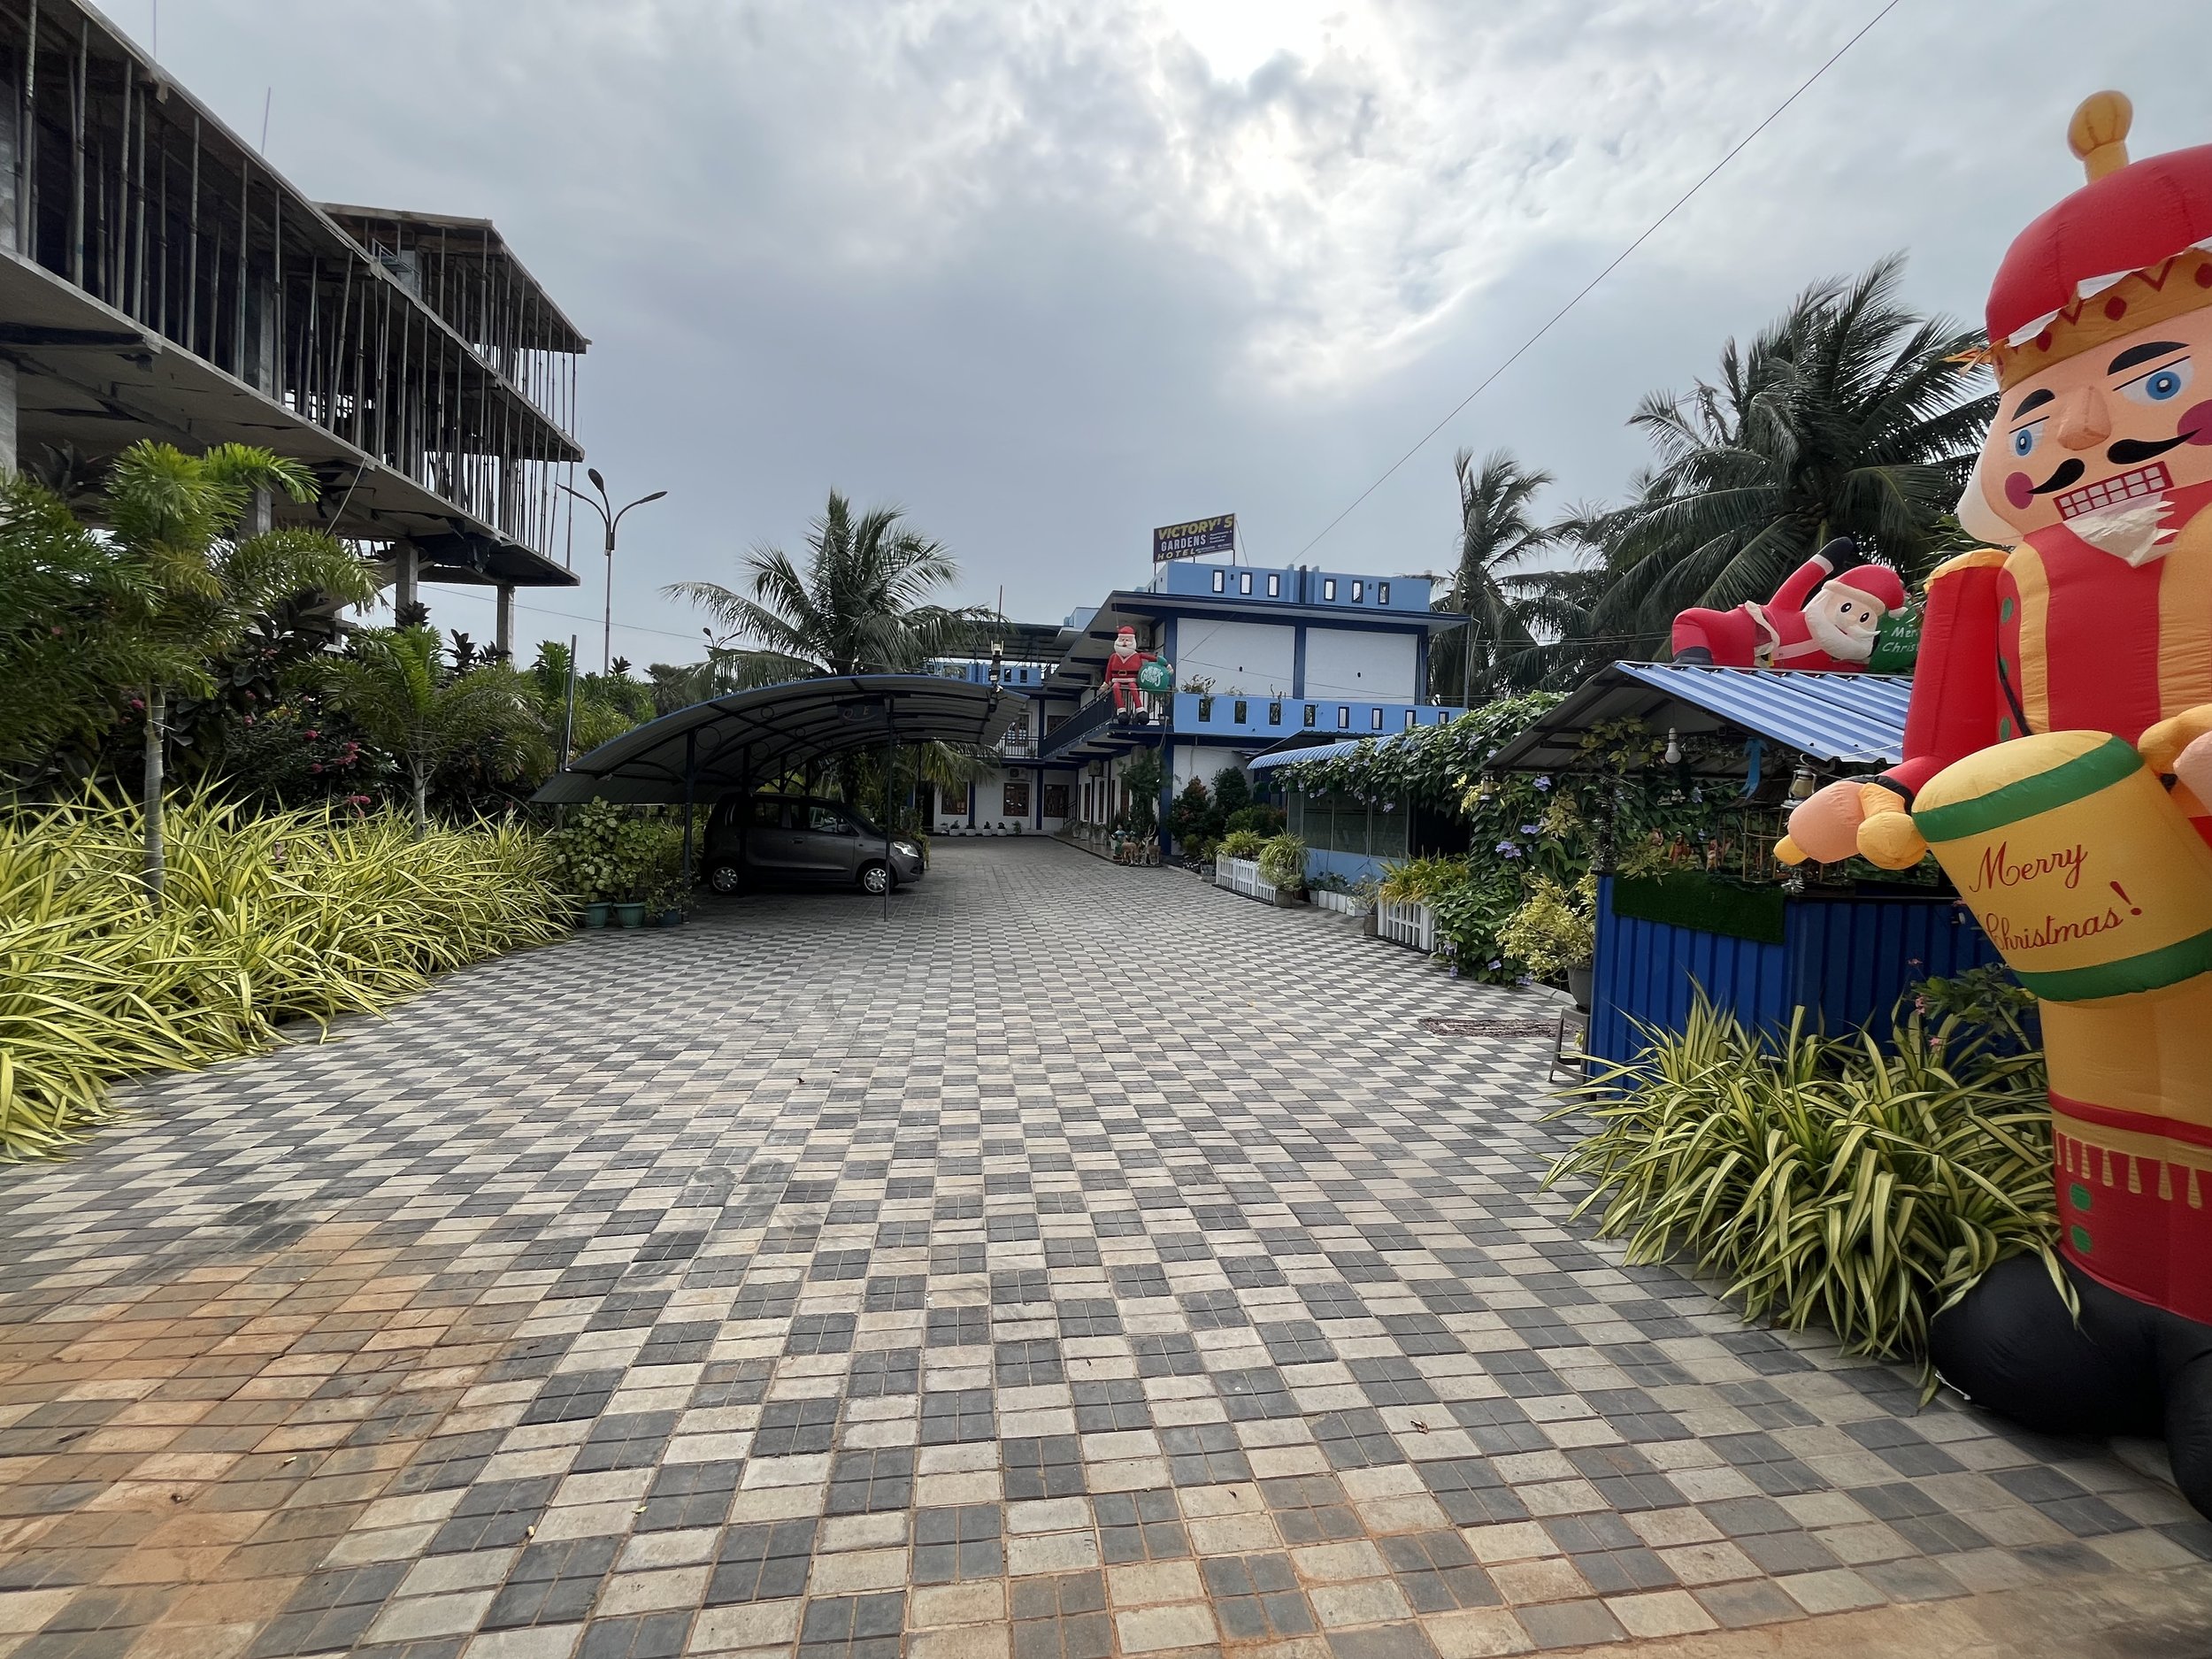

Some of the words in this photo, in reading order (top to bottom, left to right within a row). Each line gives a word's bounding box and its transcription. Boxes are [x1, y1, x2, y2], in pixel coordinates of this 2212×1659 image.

[1161, 534, 1206, 552] GARDENS
[1157, 548, 1196, 560] HOTEL
[1969, 841, 2088, 893] Merry
